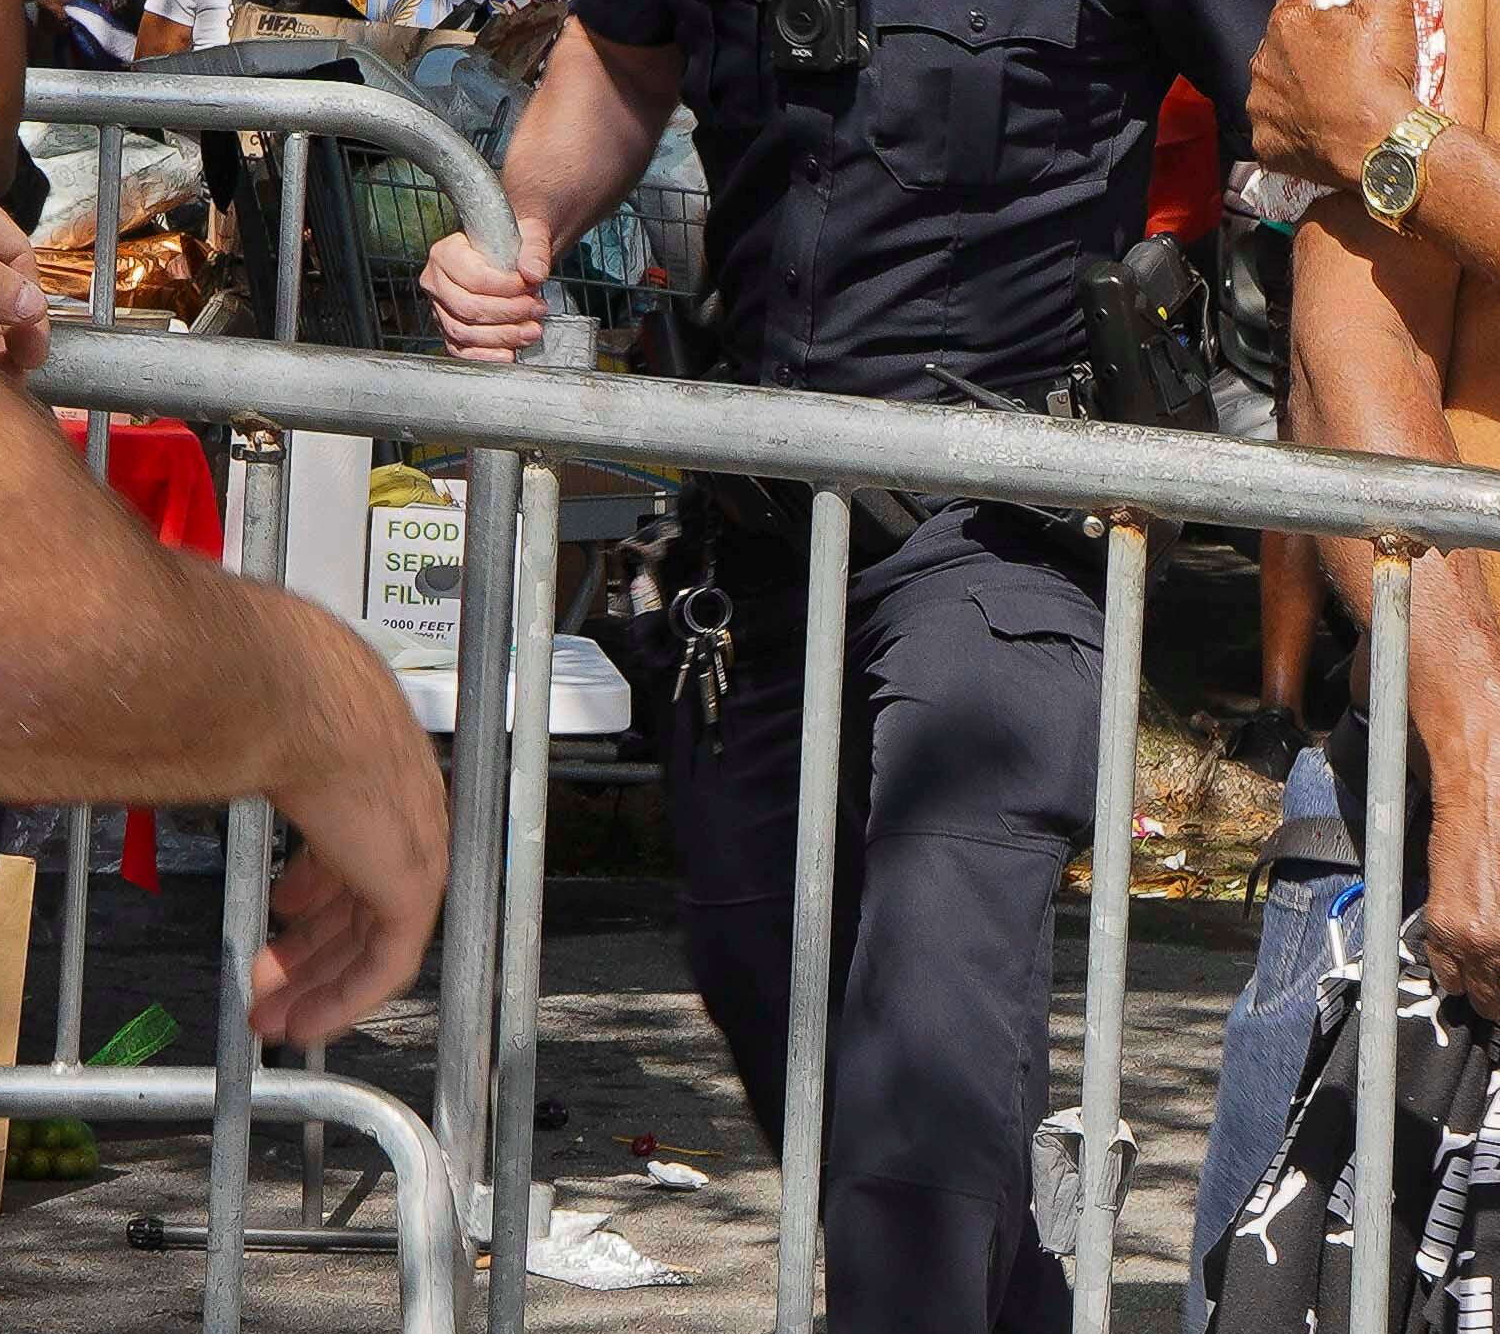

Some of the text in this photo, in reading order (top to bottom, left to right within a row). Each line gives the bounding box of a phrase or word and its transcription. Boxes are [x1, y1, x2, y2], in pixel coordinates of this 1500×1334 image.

[257, 14, 298, 33] HFA
[387, 520, 460, 542] FOOD
[385, 552, 460, 572] SERVI
[418, 620, 455, 632] FEET
